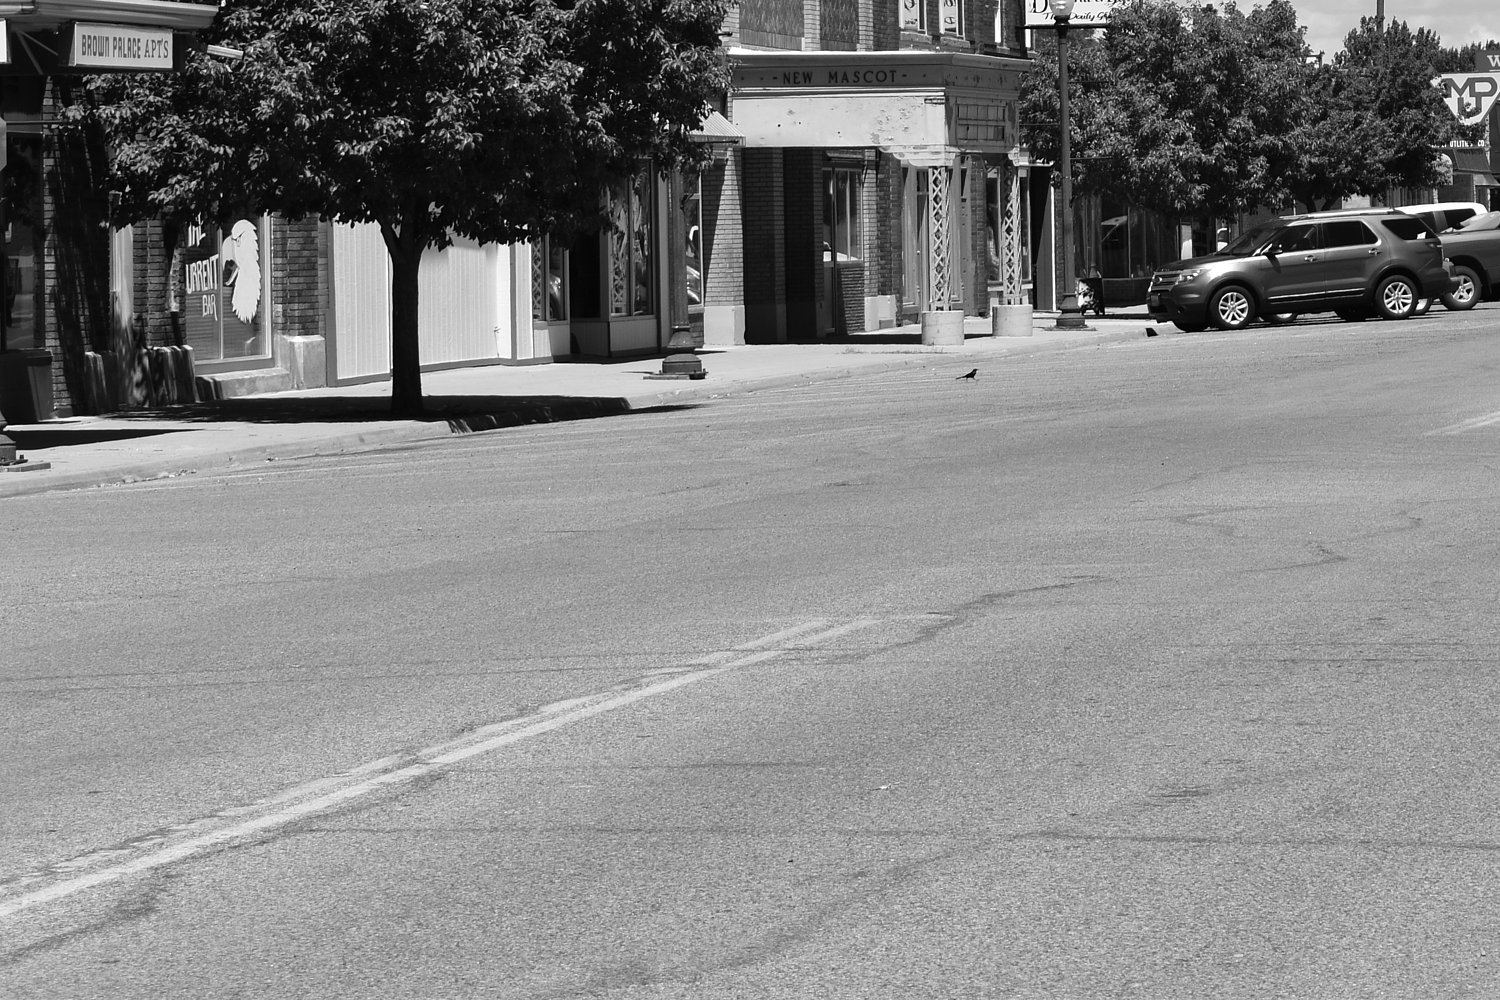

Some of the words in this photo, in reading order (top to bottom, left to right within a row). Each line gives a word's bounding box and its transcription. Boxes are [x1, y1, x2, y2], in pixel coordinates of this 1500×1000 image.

[81, 34, 110, 58] BROWN
[112, 36, 141, 59] PALACE
[144, 38, 169, 59] APT'S
[783, 71, 813, 85] NEW
[828, 70, 897, 84] MASCOT
[185, 253, 219, 295] URRENT
[202, 293, 218, 321] BAR
